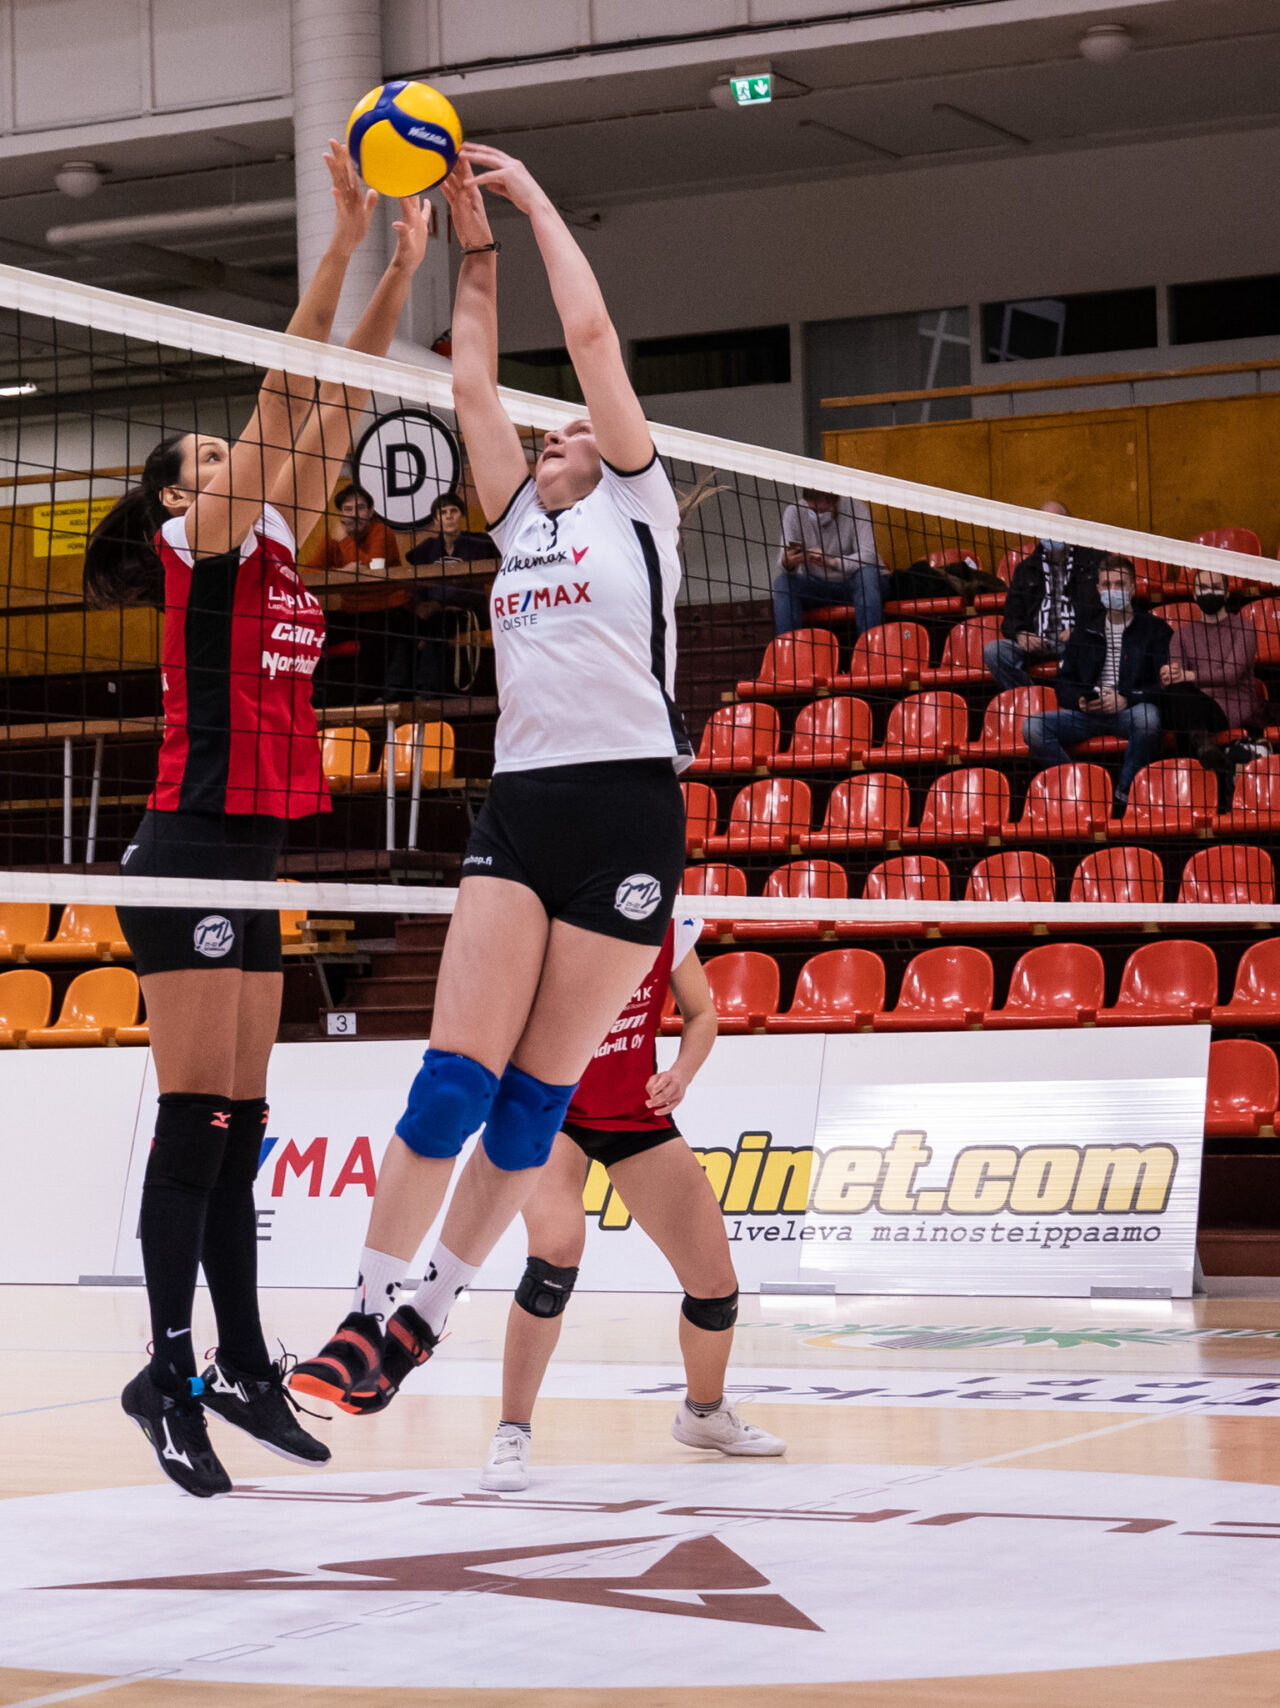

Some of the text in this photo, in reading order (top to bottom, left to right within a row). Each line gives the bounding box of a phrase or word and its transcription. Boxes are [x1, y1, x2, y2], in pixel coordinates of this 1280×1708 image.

[386, 443, 426, 497] D
[494, 581, 592, 618] RE/MAX
[500, 613, 538, 633] OISTE
[336, 1015, 348, 1032] 3
[727, 1220, 1161, 1249] lveleva mainosteippaamo
